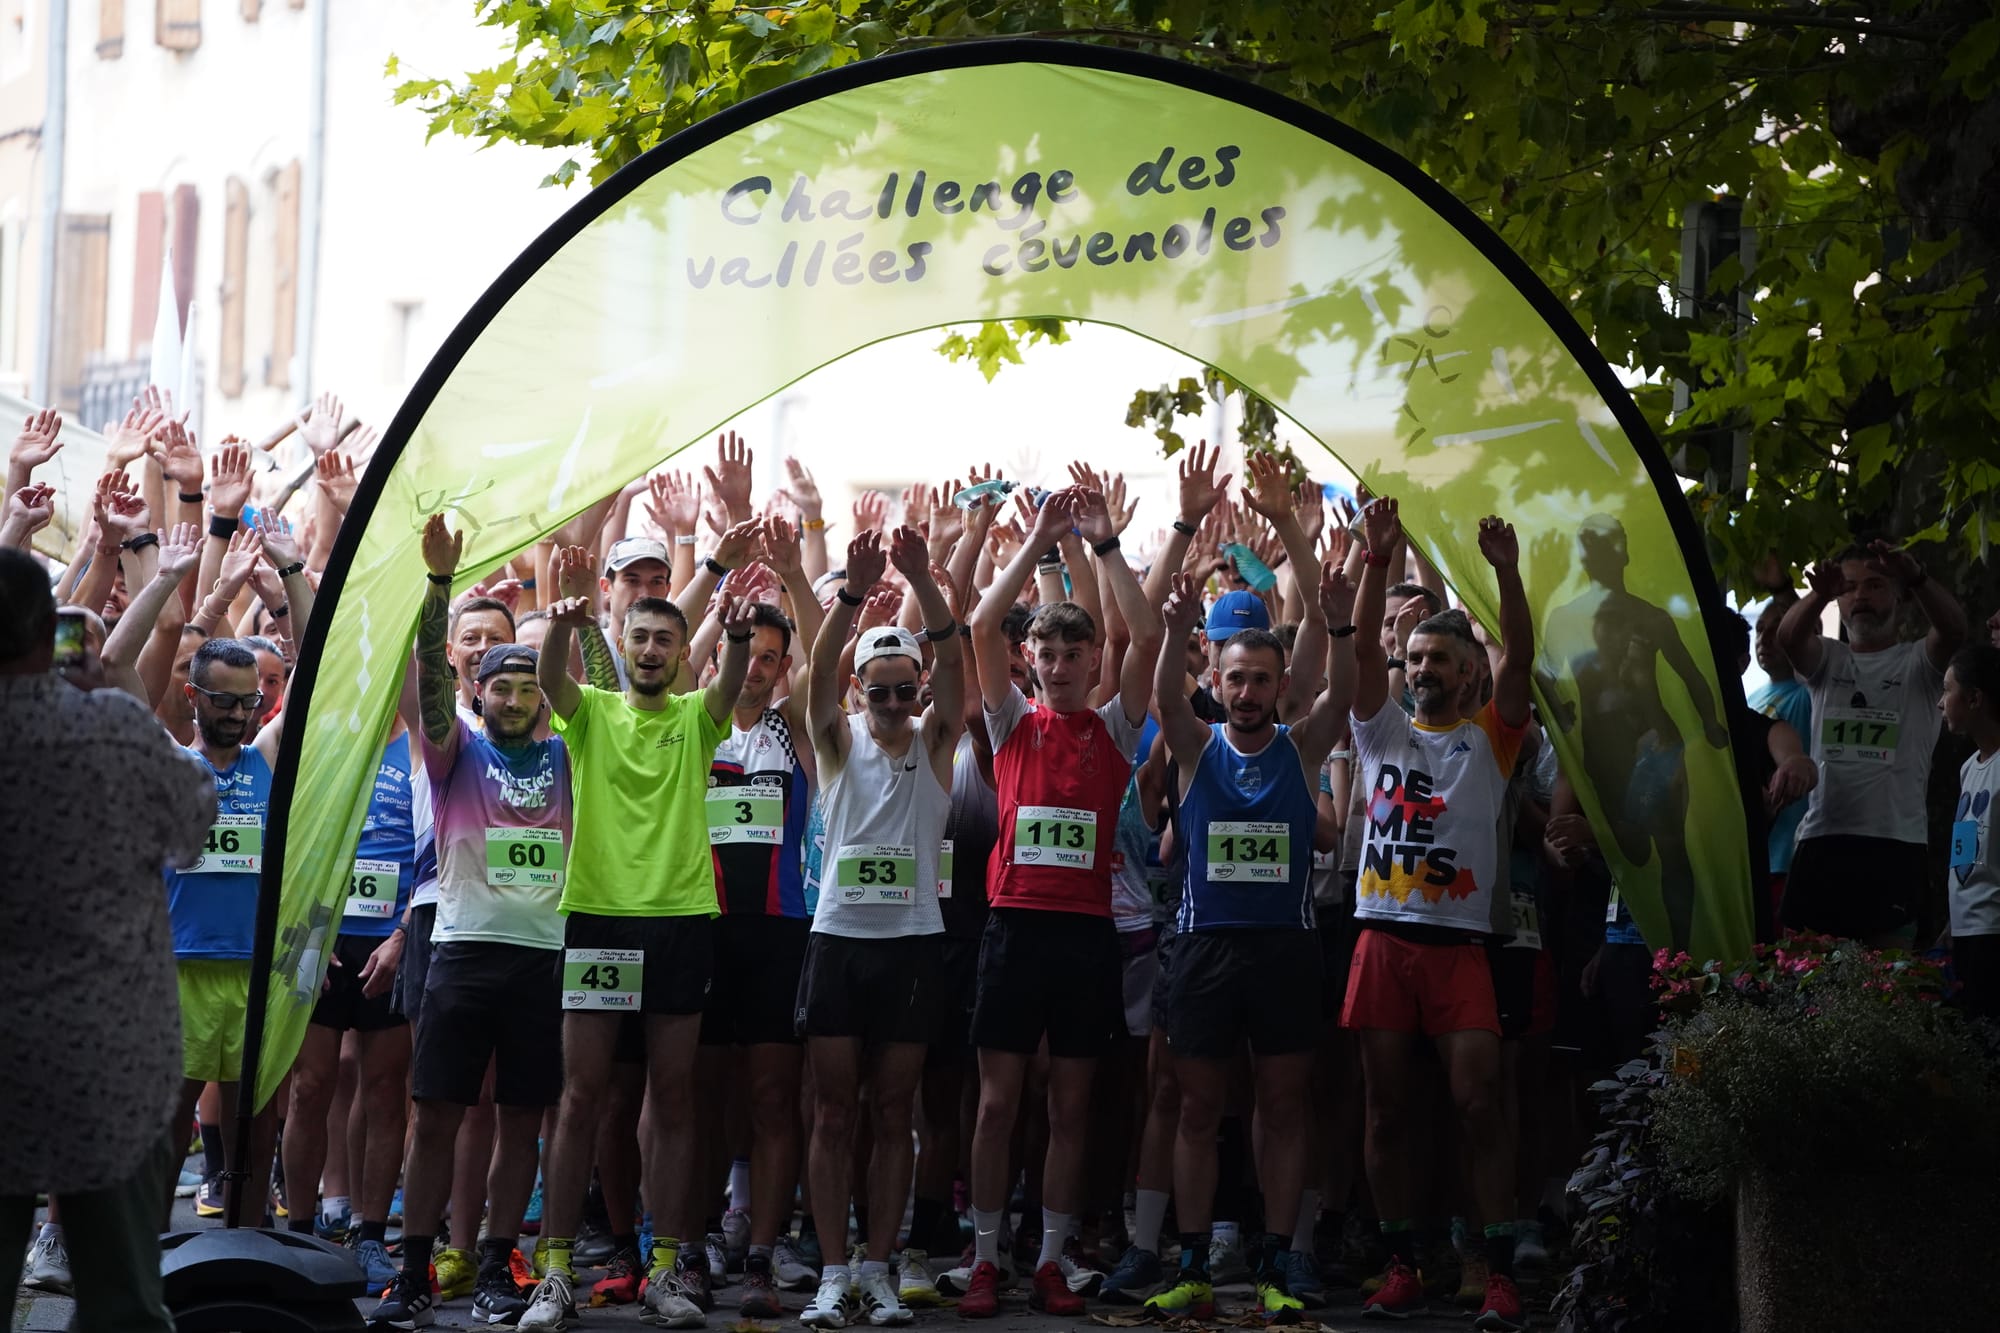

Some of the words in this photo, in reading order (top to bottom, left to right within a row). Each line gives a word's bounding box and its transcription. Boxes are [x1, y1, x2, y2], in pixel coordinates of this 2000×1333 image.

[721, 169, 1079, 231] Challenge
[1126, 144, 1242, 197] des
[686, 231, 934, 290] vallées
[981, 205, 1288, 278] cévenoles
[1833, 721, 1887, 745] 117
[1373, 764, 1434, 803] DE
[735, 801, 753, 824] 3
[1368, 804, 1435, 844] ME
[204, 830, 239, 853] 46
[1027, 821, 1085, 848] 113
[508, 843, 545, 867] 60
[1220, 837, 1279, 862] 134
[1955, 839, 1963, 856] 5
[858, 860, 897, 884] 53
[1363, 843, 1457, 886] NTS
[580, 965, 620, 990] 43
